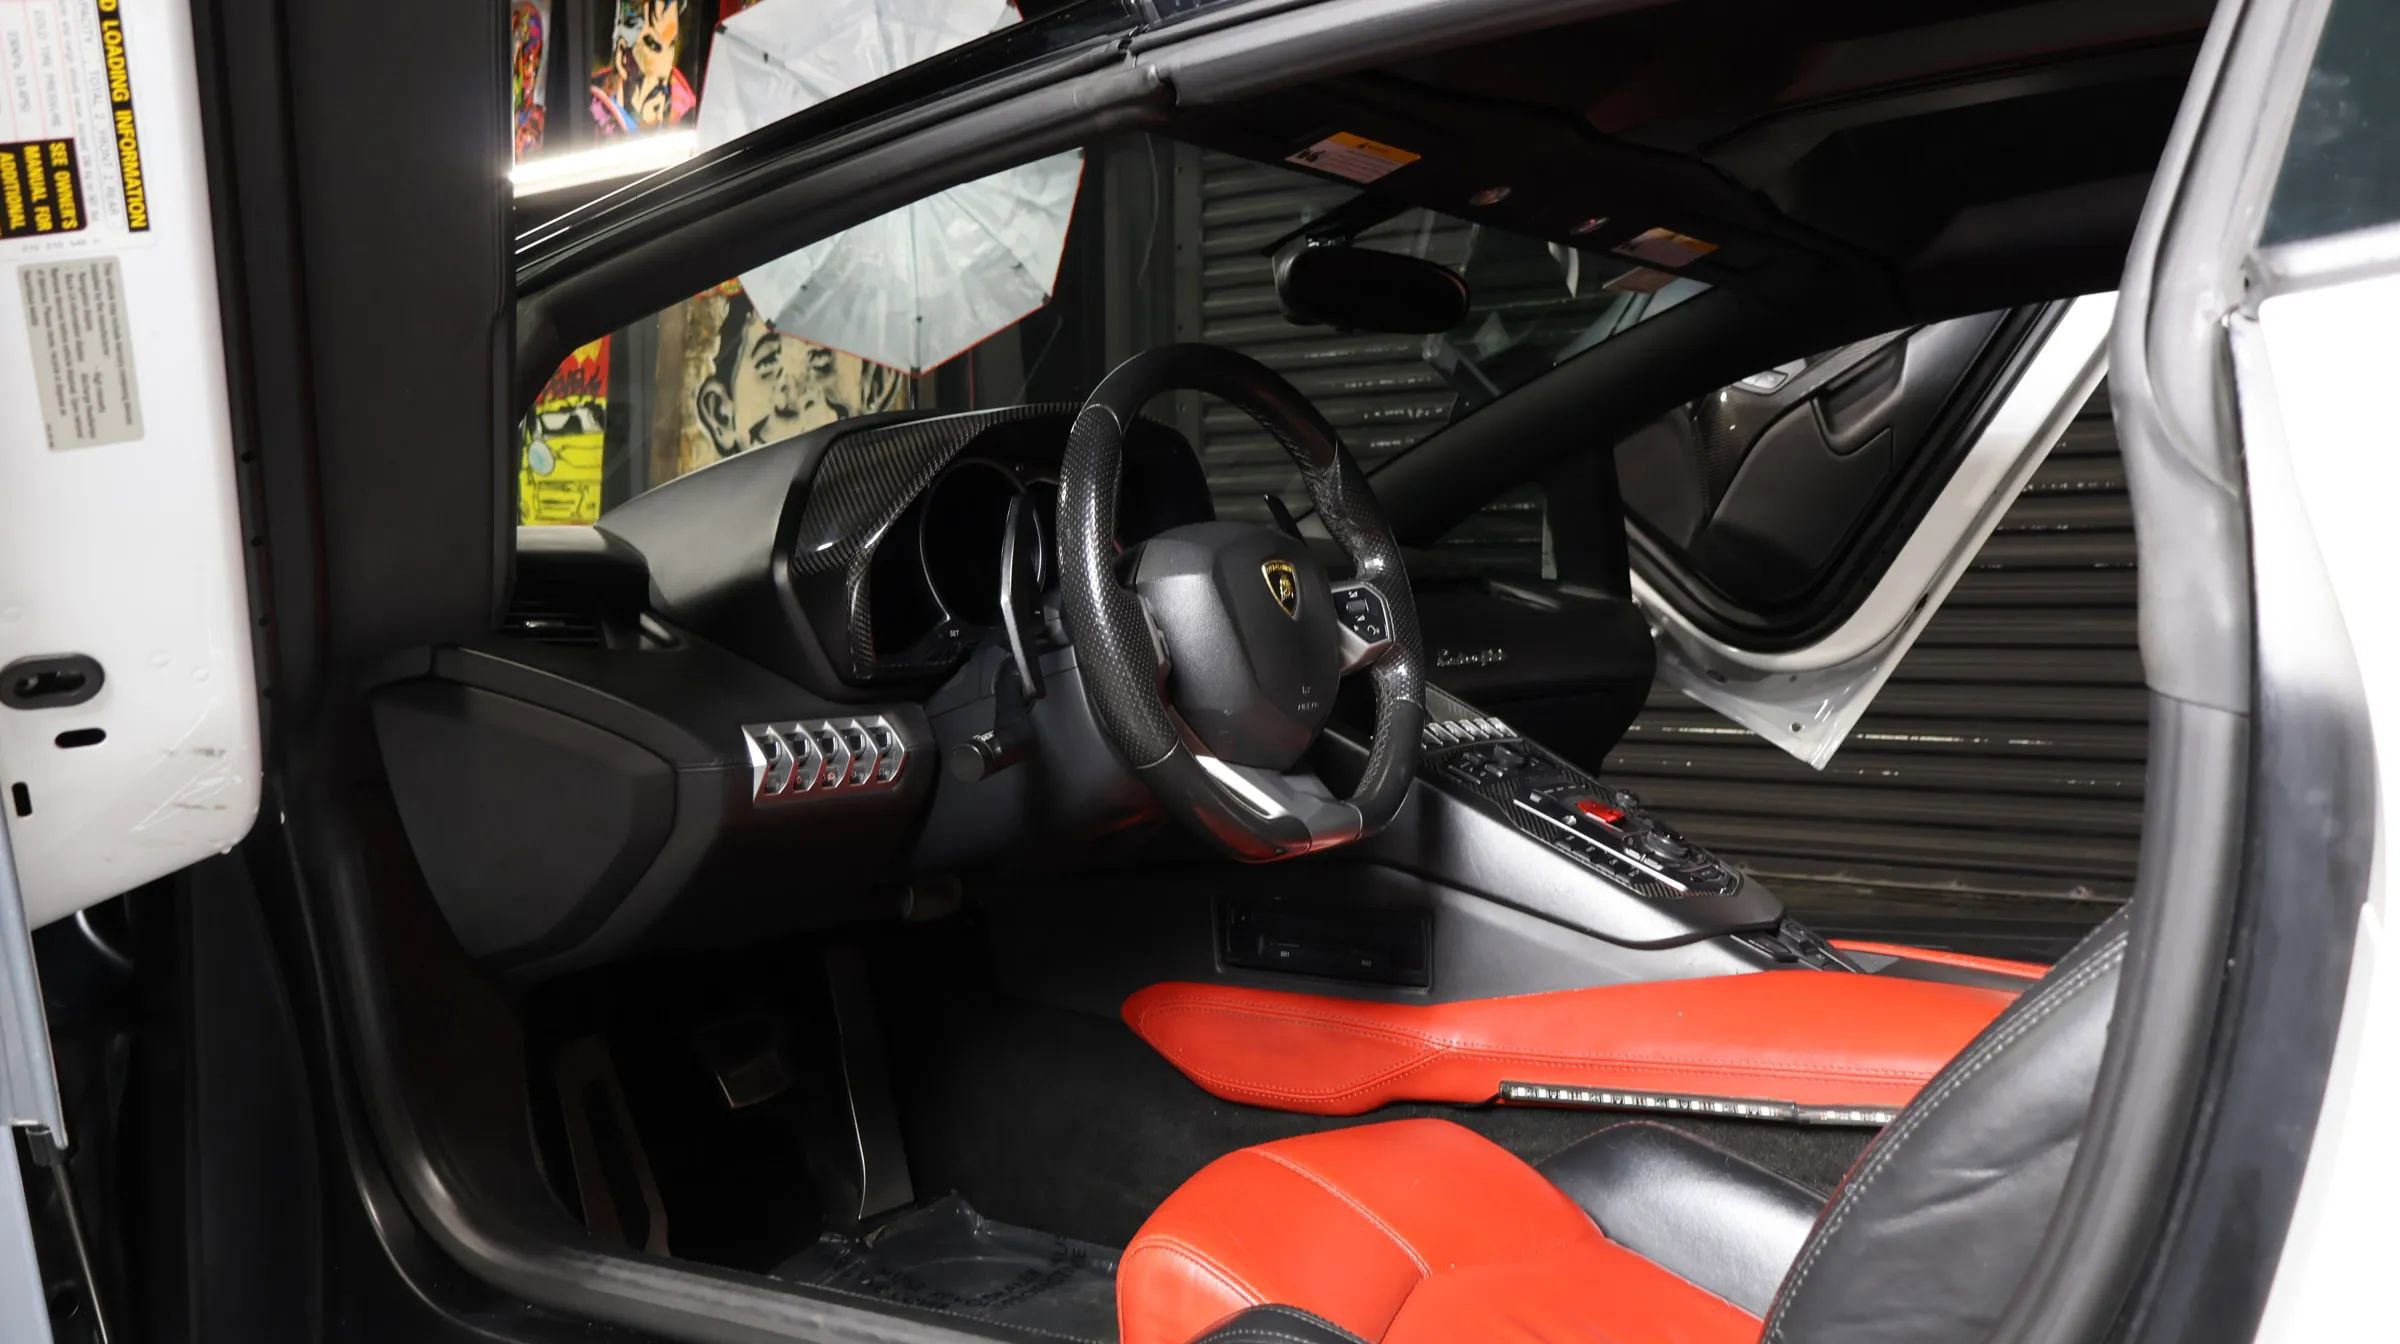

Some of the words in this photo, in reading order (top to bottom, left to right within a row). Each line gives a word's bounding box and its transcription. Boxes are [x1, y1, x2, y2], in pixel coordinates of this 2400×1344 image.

[102, 20, 130, 102] LOADING
[23, 144, 48, 203] MANUAL
[49, 141, 68, 167] SEE
[114, 109, 148, 230] INFORMATION
[0, 152, 27, 231] ADDITIONAL
[34, 205, 53, 232] FOR
[53, 170, 79, 231] OWNER'S
